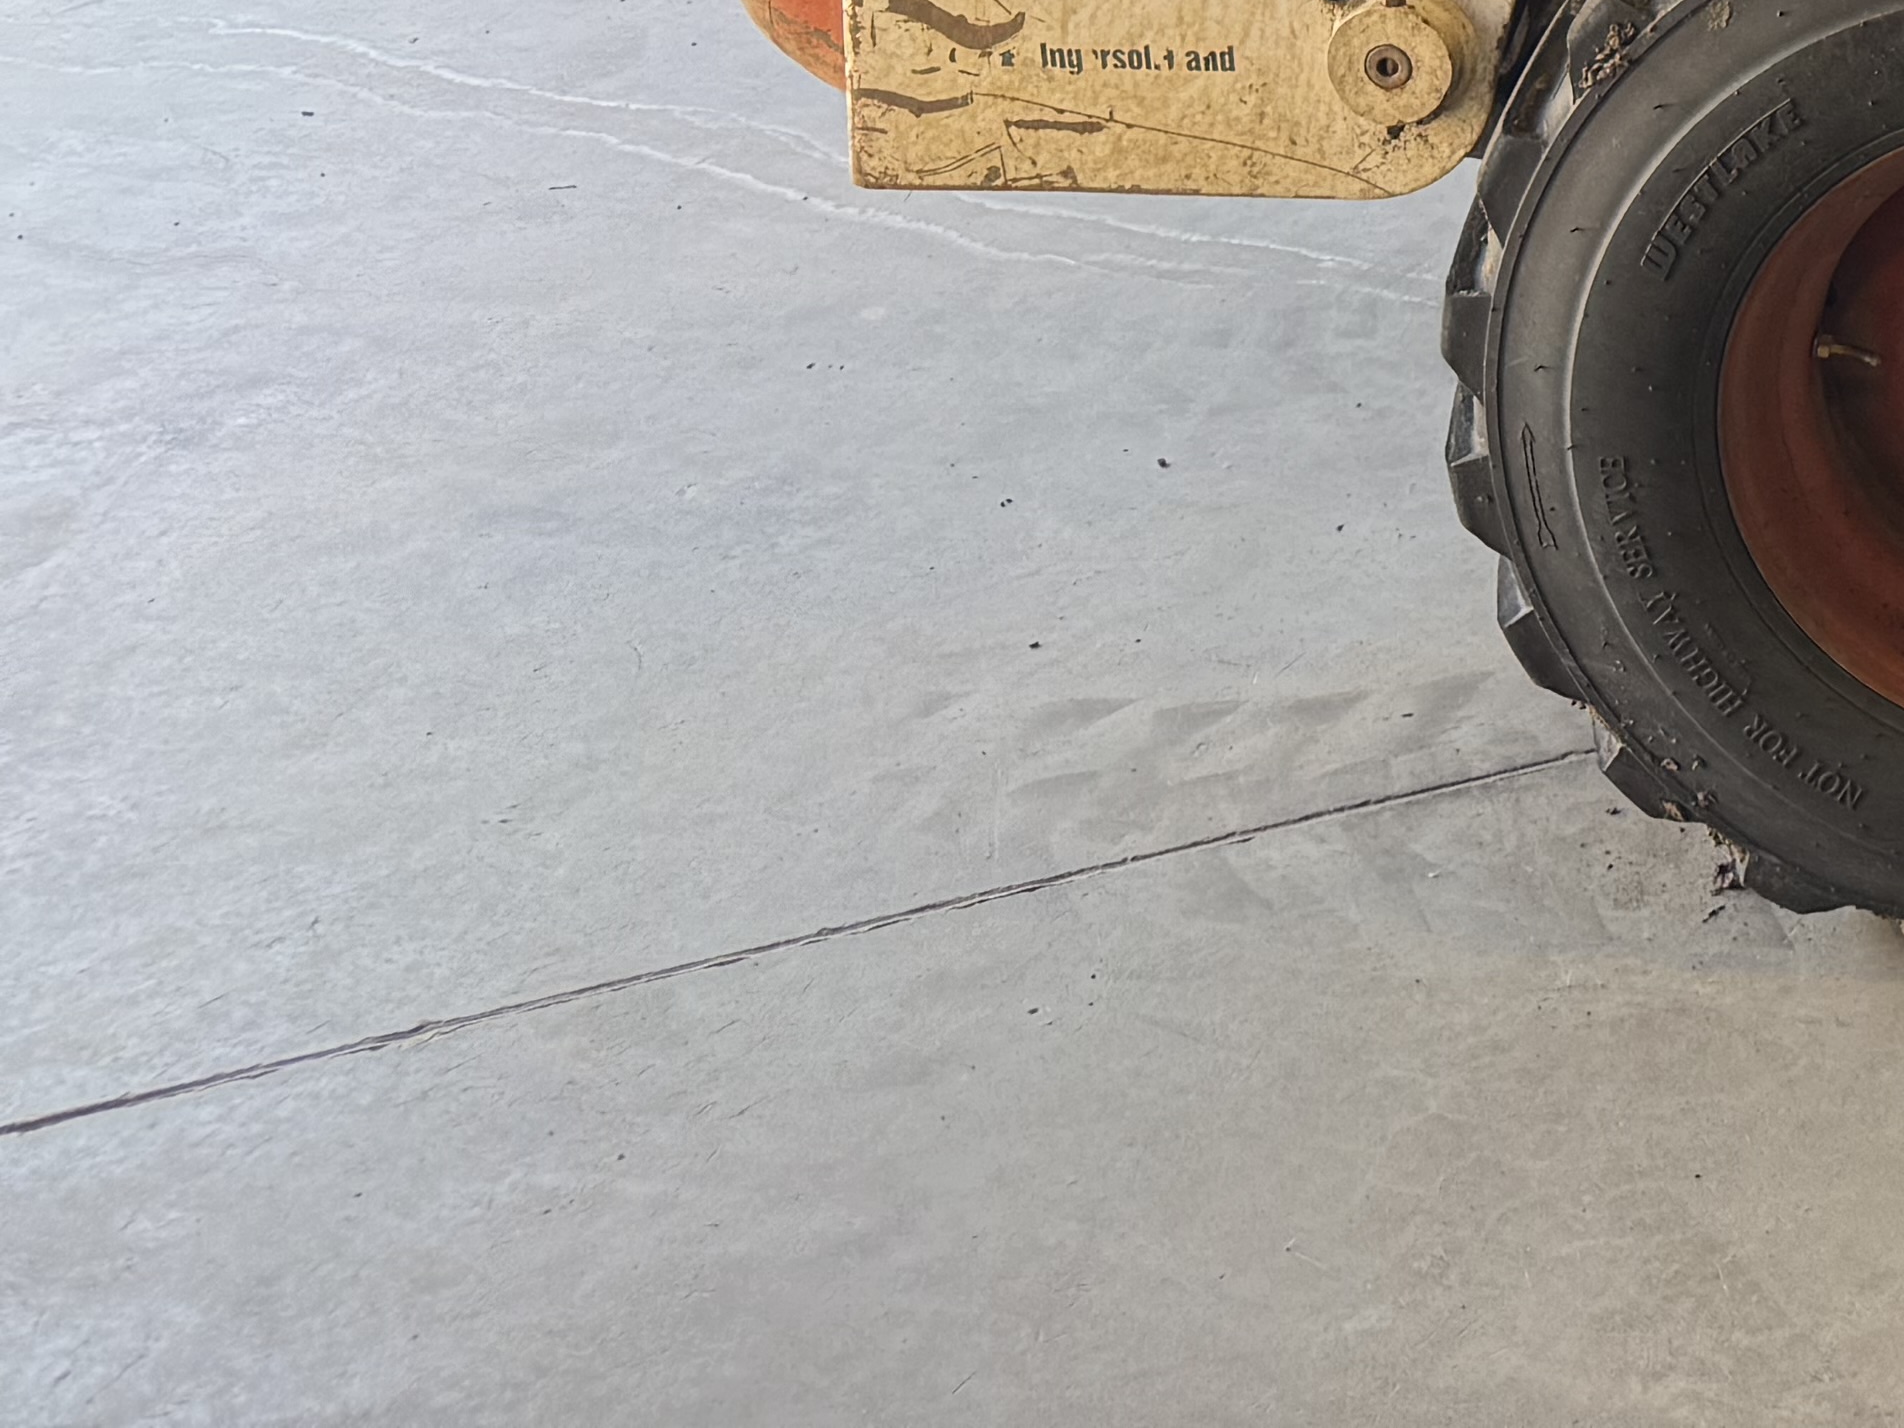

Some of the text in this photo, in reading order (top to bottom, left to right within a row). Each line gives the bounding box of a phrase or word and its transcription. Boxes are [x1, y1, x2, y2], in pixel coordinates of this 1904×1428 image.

[1639, 96, 1802, 283] WESTLAKE
[1598, 453, 1865, 812] NOT FOR HIGHWAY SERVICE
